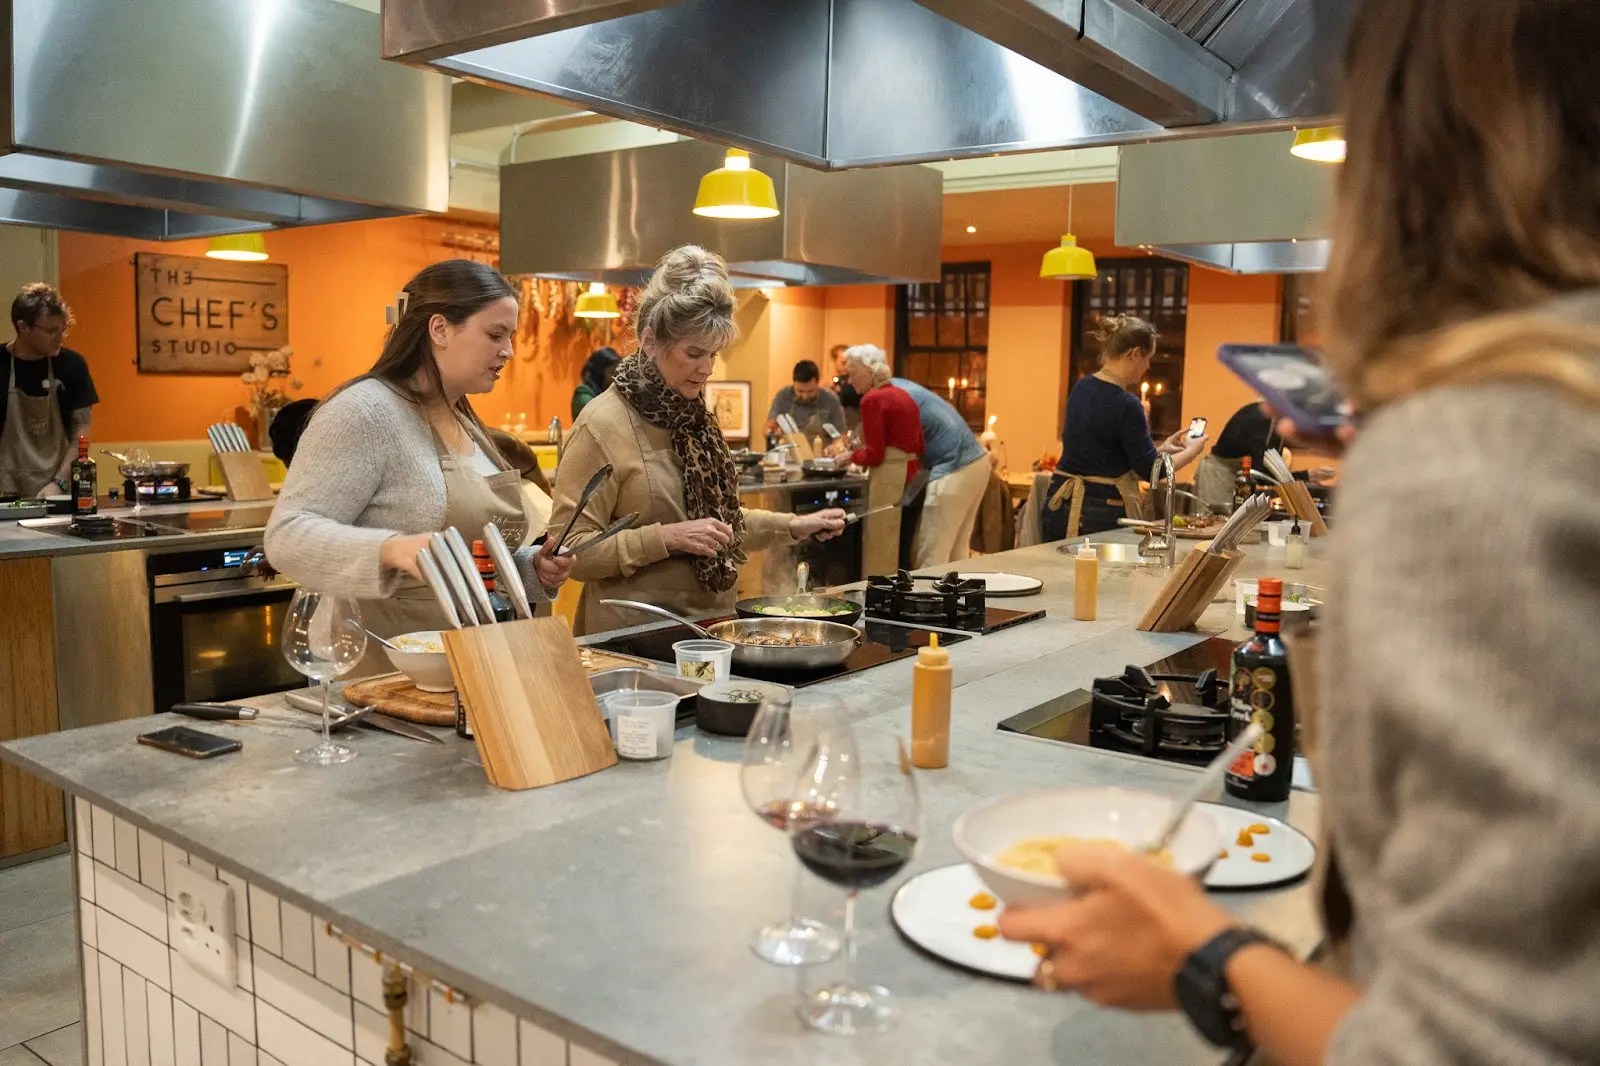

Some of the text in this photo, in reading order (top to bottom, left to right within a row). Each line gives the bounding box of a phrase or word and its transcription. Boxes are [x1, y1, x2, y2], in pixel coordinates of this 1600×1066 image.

[151, 268, 192, 285] THE
[152, 297, 278, 331] CHEF'S
[152, 339, 237, 355] STUDIO
